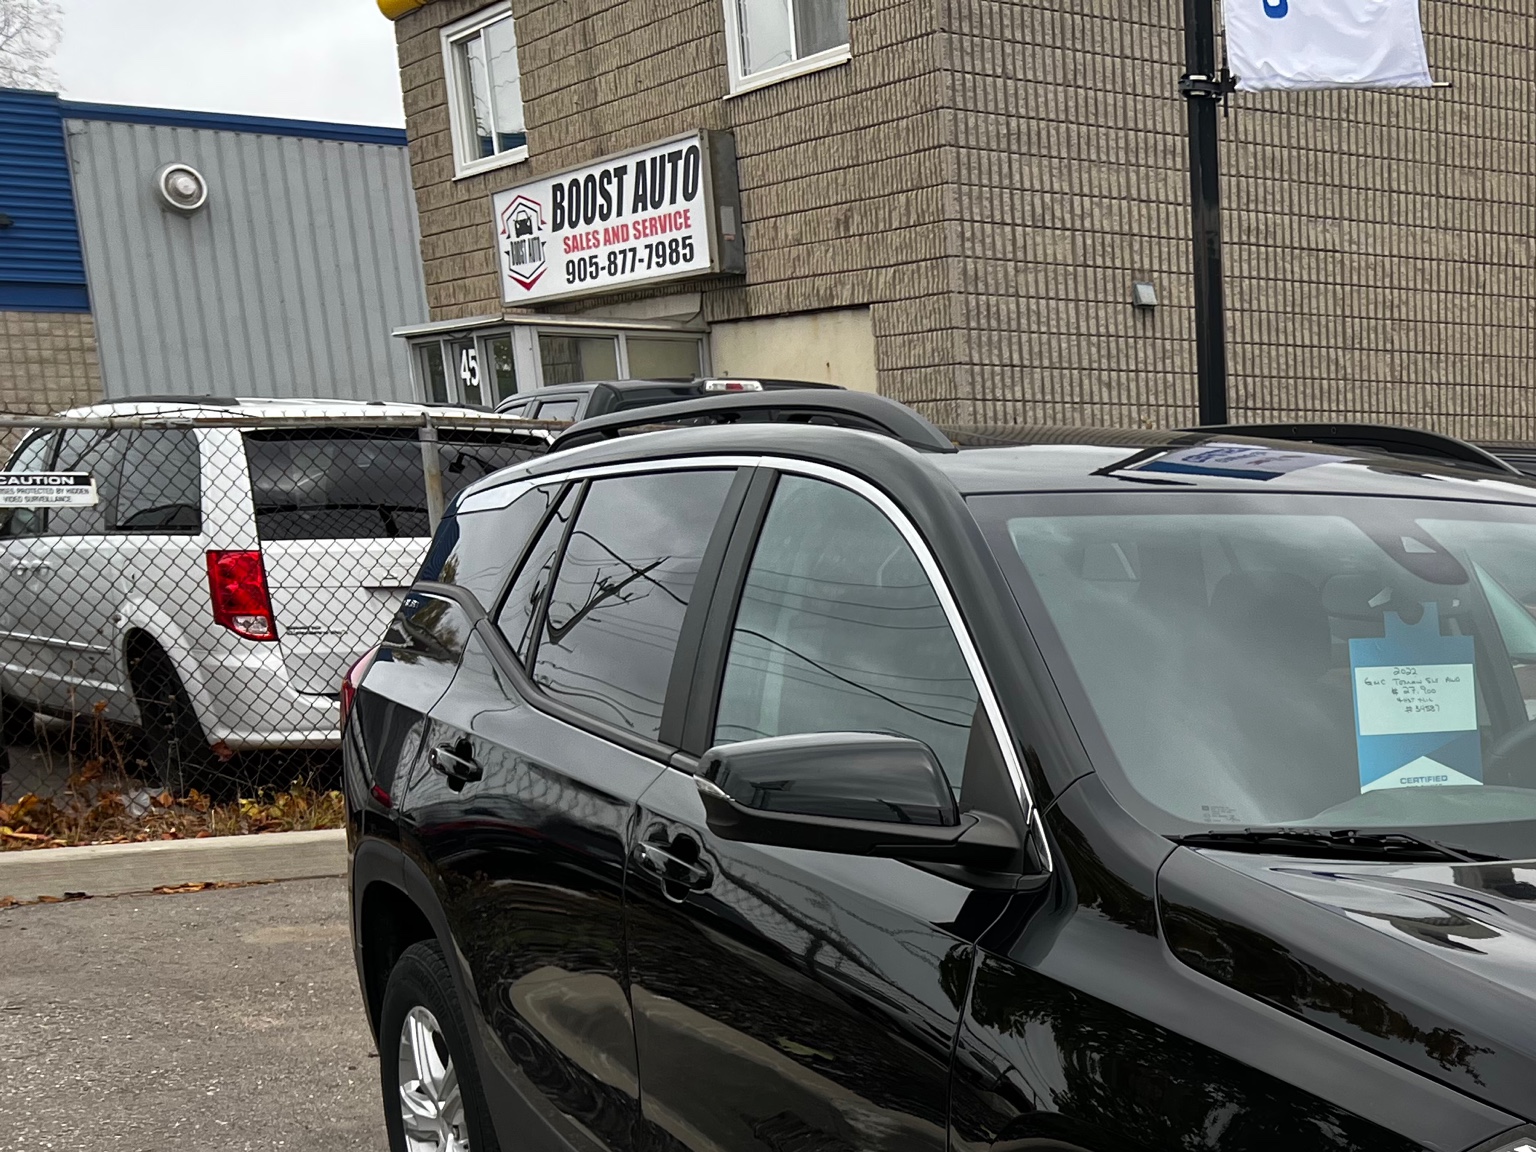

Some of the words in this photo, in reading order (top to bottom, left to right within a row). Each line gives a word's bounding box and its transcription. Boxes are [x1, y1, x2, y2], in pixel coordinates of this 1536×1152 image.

[552, 164, 628, 234] BOOST
[632, 144, 701, 215] AUTO
[563, 229, 601, 255] SALES
[603, 223, 630, 247] AND
[632, 208, 692, 240] SERVICE
[511, 238, 527, 266] BOOST
[565, 235, 695, 285] 905-877-7985
[460, 348, 479, 387] 45
[3, 495, 23, 503] VIDEO
[16, 487, 54, 495] PROTECTED
[1392, 666, 1418, 676] 2022
[1363, 677, 1386, 686] GMC
[1399, 774, 1449, 785] CERTIFIED
